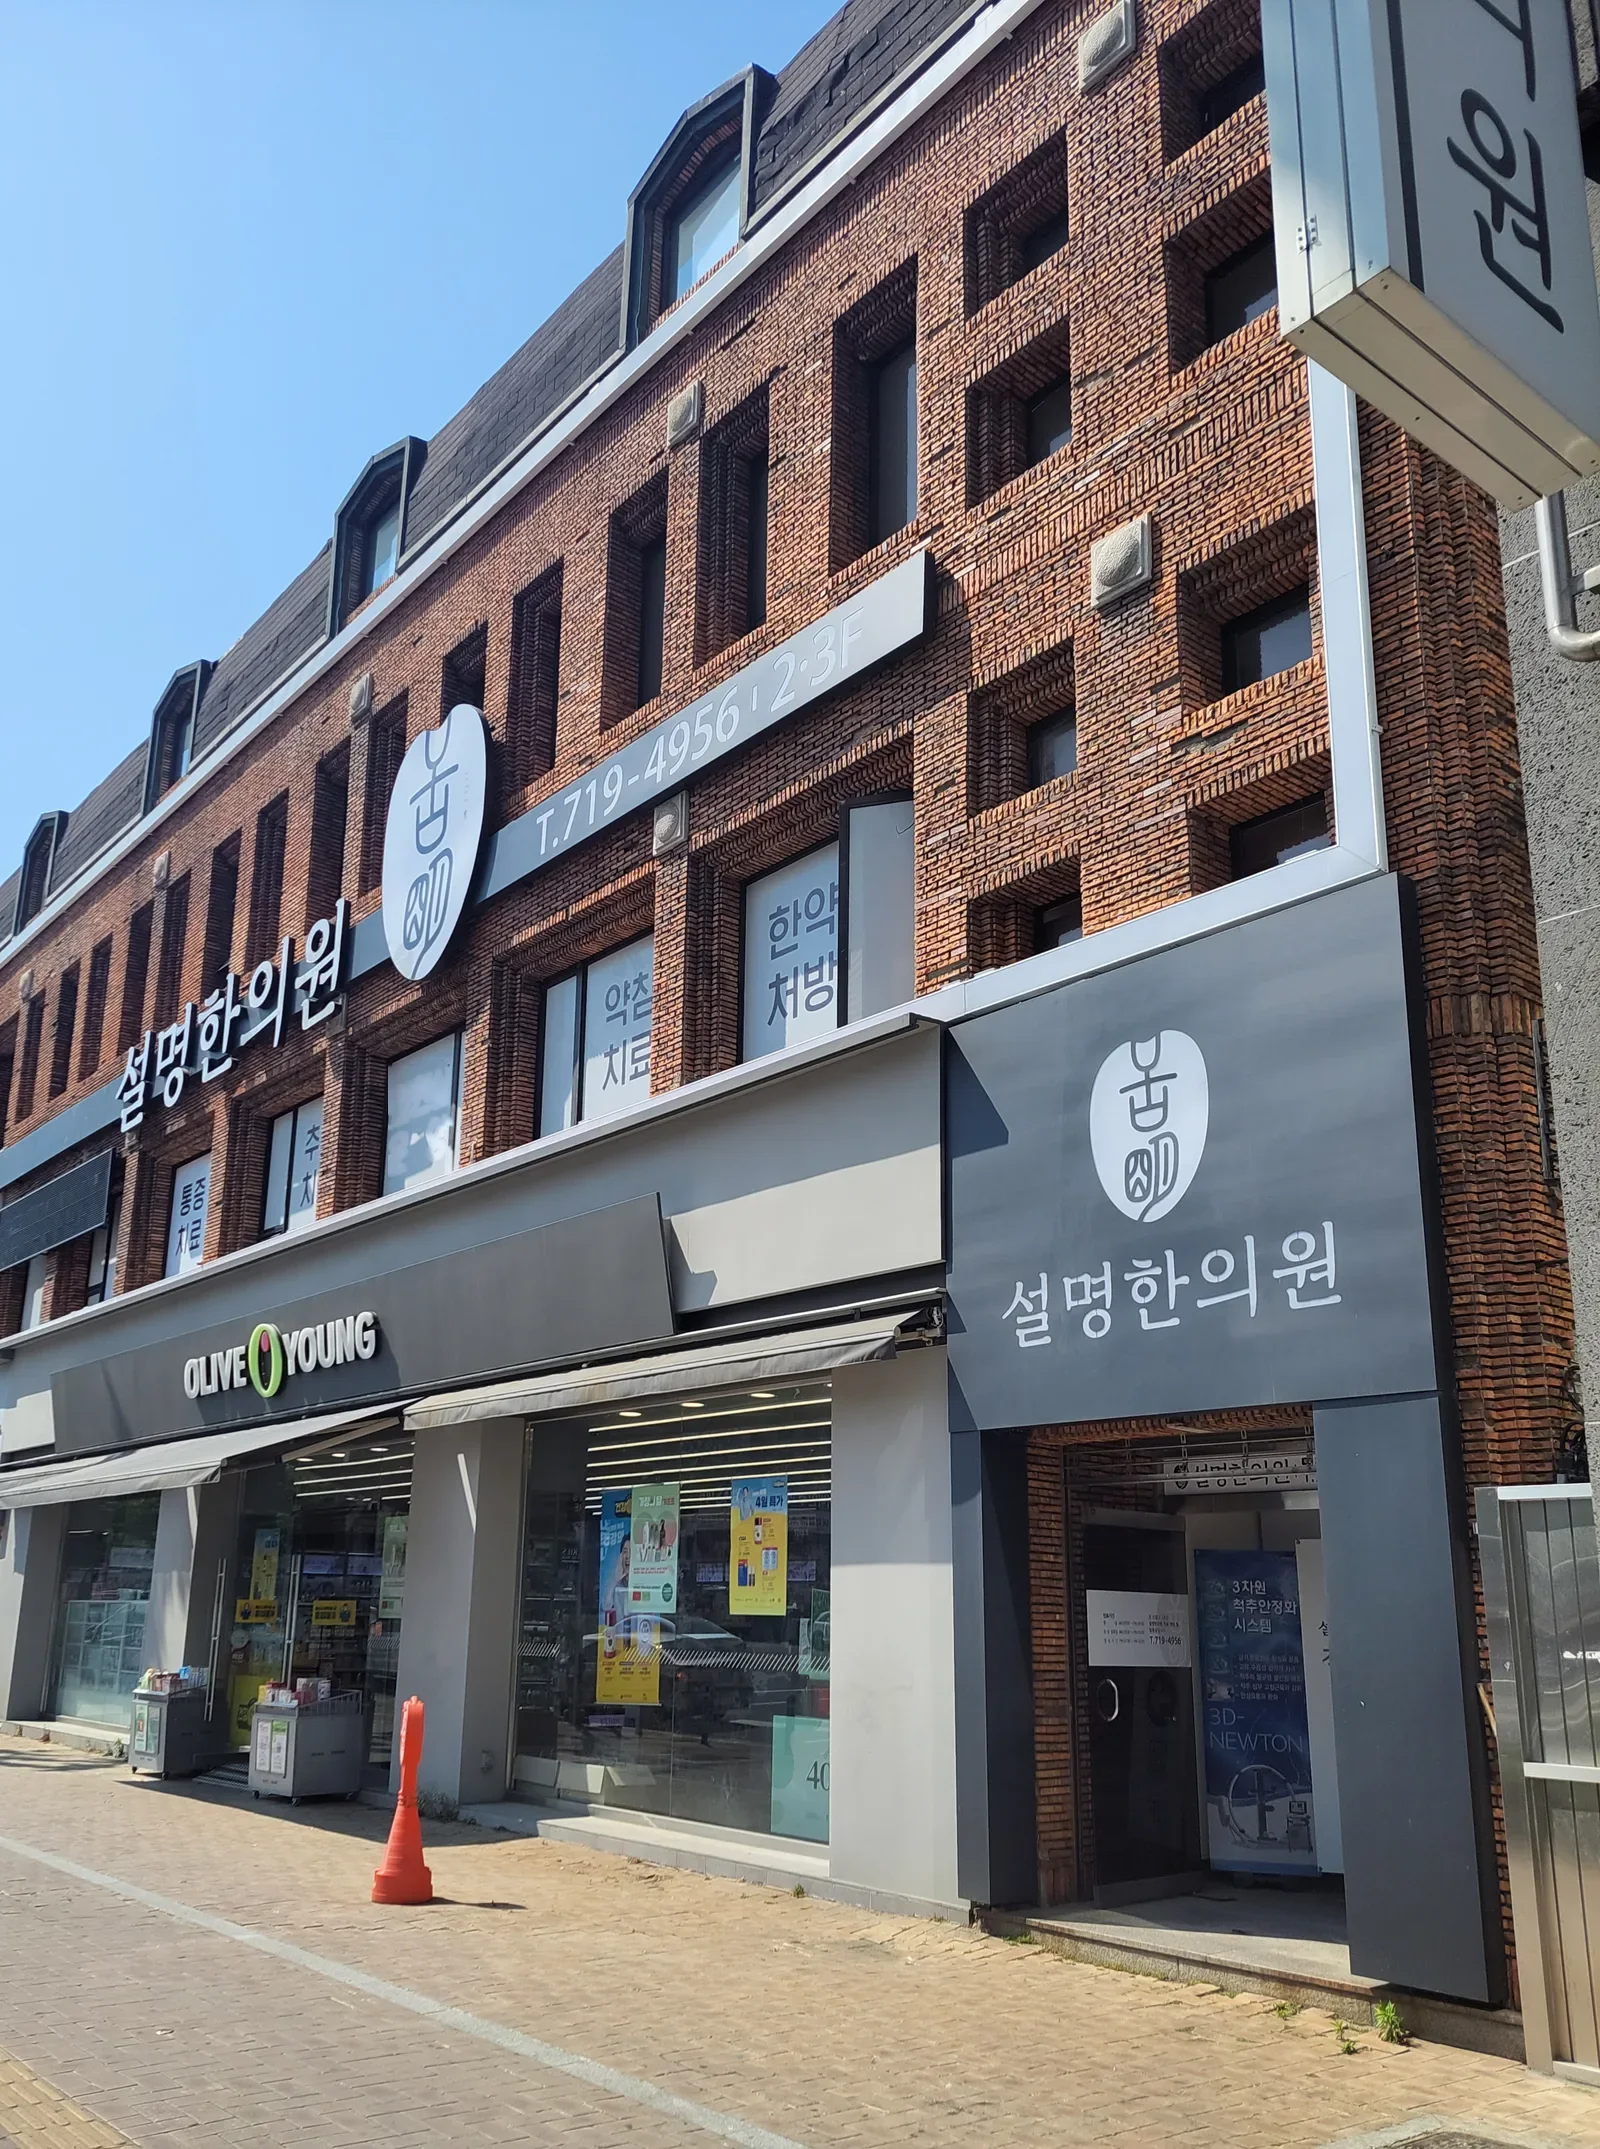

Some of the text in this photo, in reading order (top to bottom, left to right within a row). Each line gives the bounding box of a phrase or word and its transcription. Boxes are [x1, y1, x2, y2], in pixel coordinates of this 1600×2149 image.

[535, 684, 741, 856] T.719-4956
[115, 898, 347, 1134] 설명한의원
[1002, 1221, 1342, 1348] 설명한의원
[184, 1311, 377, 1400] OLIVE YOUNG
[1232, 1579, 1267, 1595] 3차원
[1233, 1598, 1298, 1616] 척추안정화
[1234, 1617, 1273, 1634] 시스템
[1209, 1731, 1304, 1753] NEWTON
